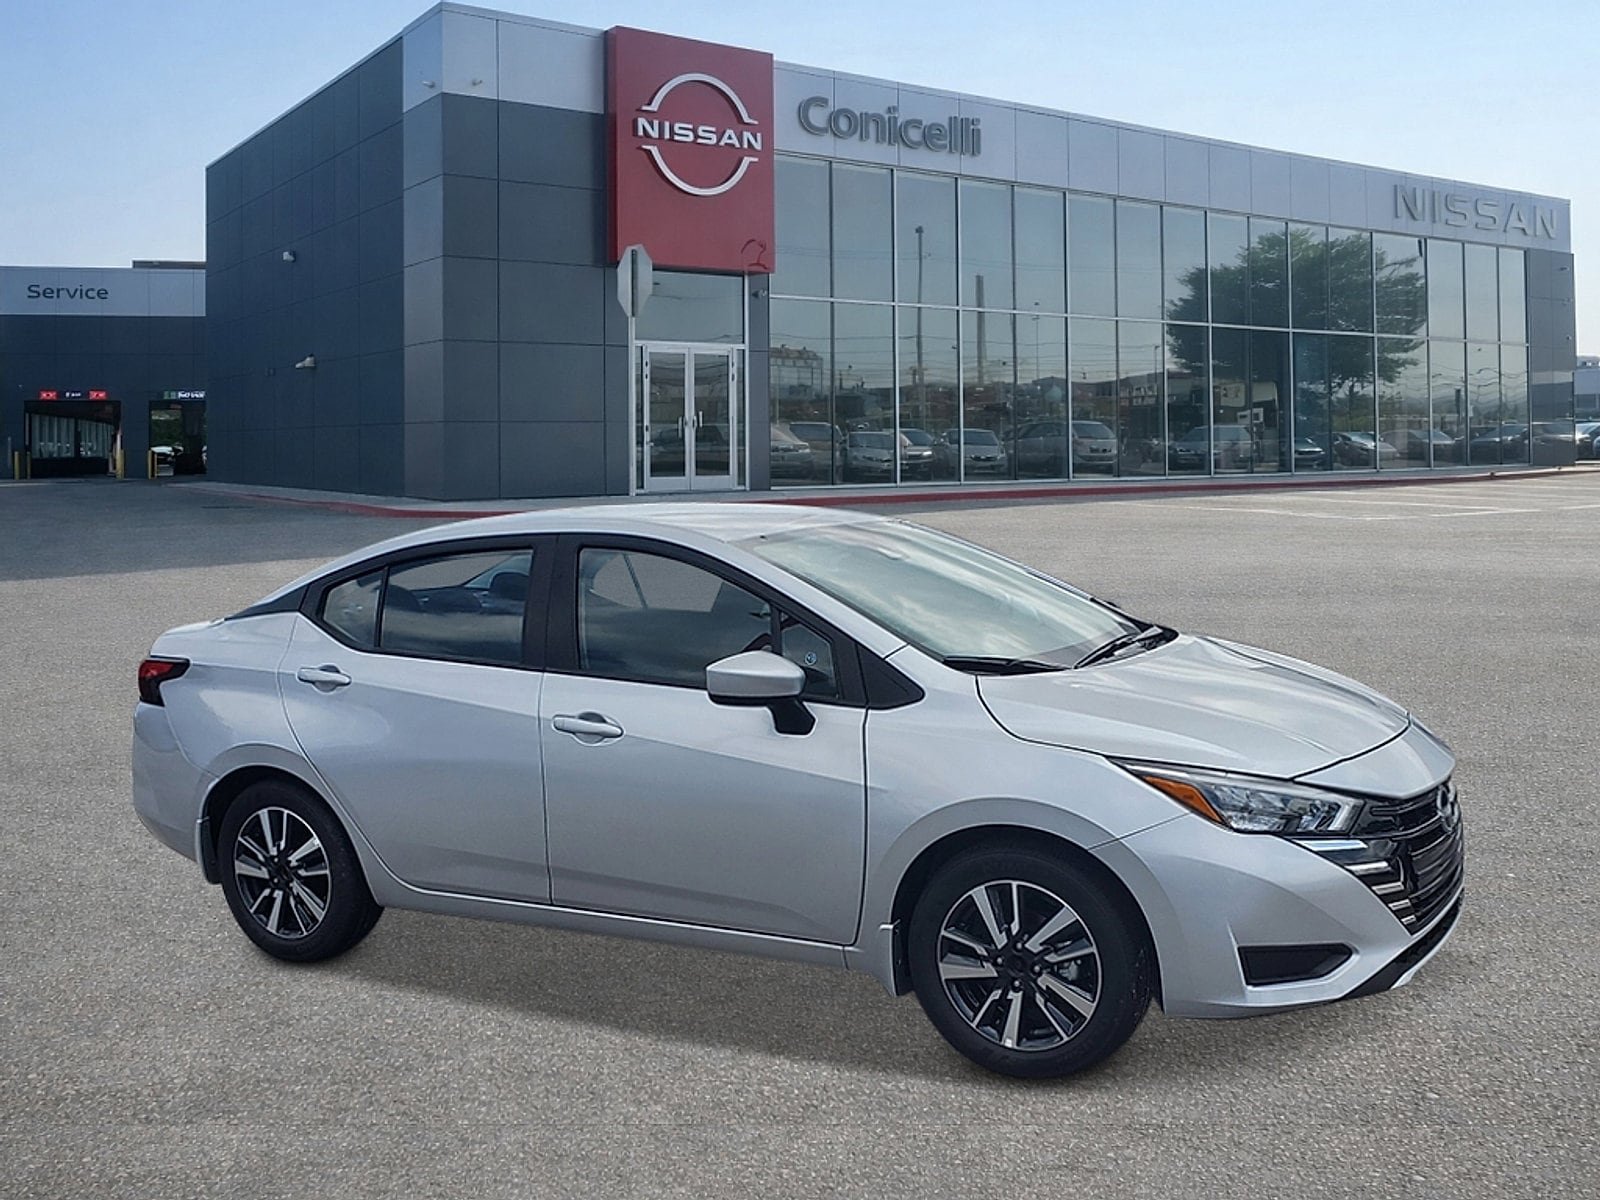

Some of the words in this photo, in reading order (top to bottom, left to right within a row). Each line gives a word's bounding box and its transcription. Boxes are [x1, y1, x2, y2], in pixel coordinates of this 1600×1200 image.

[636, 117, 762, 151] NISSAN
[798, 96, 982, 156] Conicelli
[1393, 184, 1557, 240] NISSAN
[27, 284, 109, 300] Service
